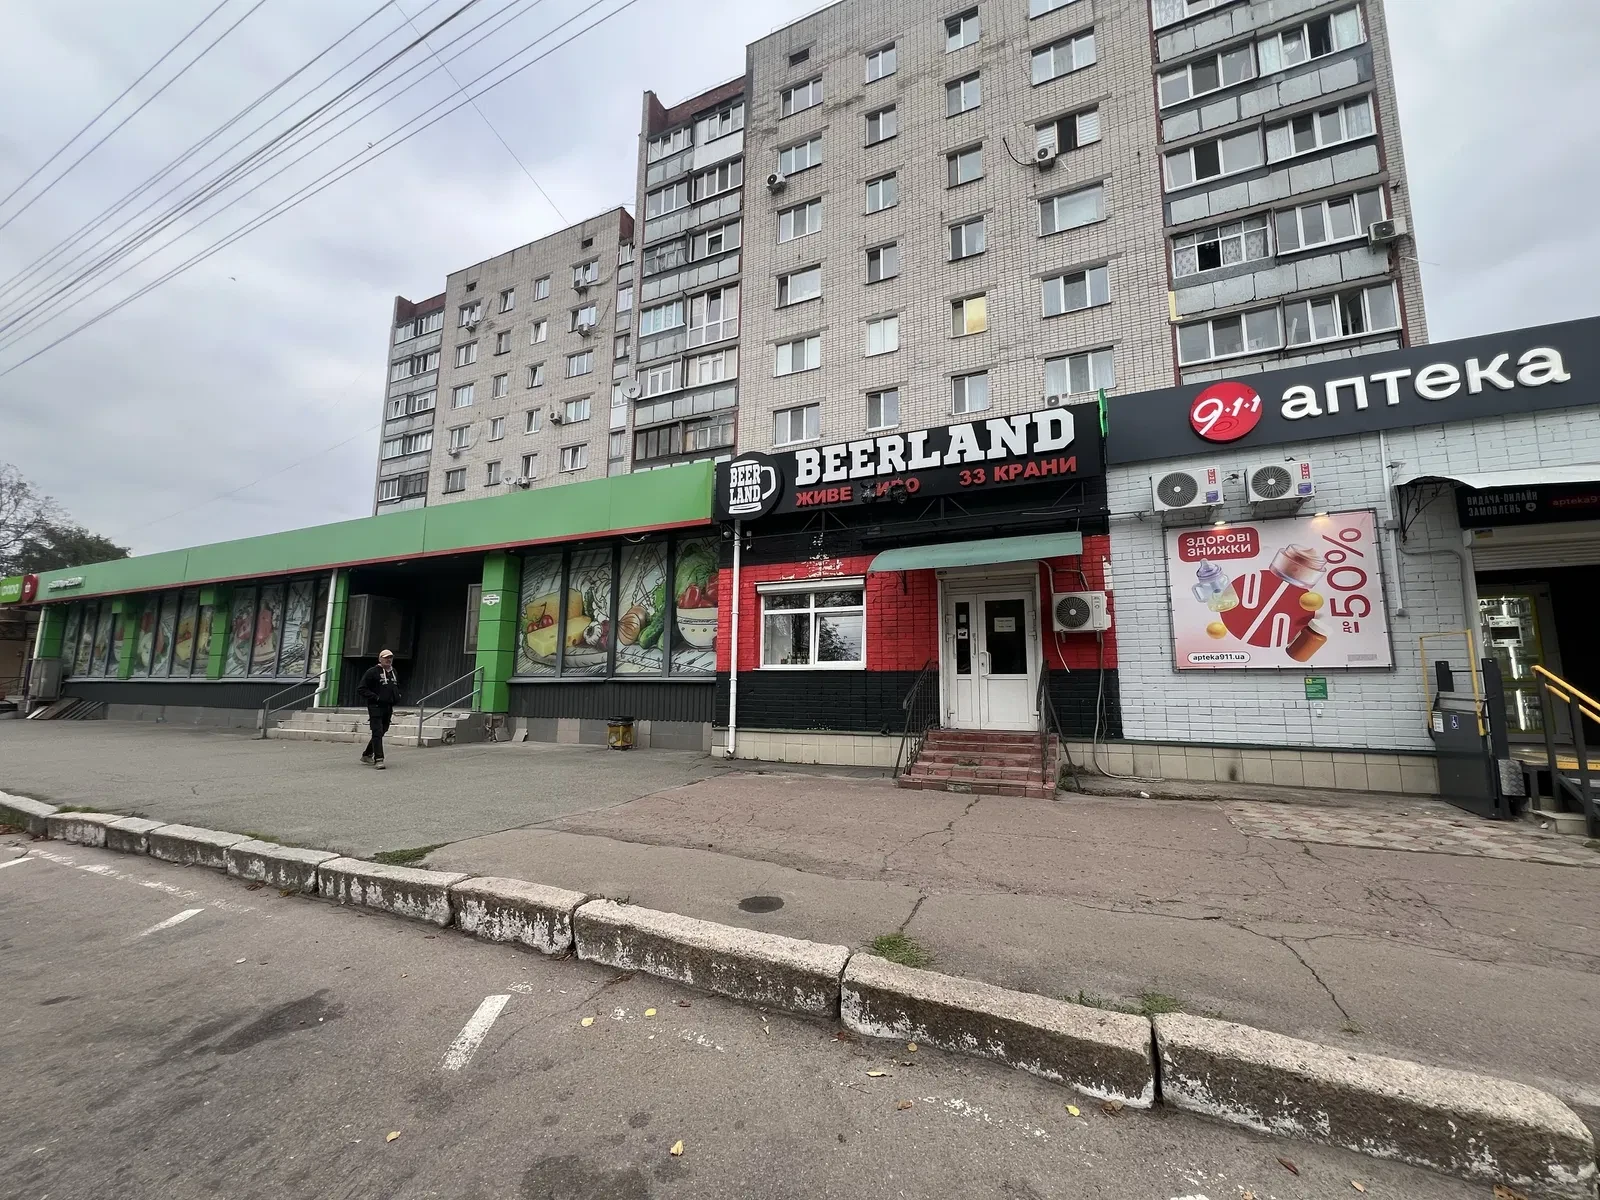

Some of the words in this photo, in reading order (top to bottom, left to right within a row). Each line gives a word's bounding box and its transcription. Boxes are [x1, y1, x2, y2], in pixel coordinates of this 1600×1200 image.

[1280, 347, 1571, 420] аптека
[795, 408, 1075, 486] BEERLAND
[729, 463, 761, 488] BEER
[795, 486, 853, 507] ЖИВЕ
[959, 468, 986, 485] 33
[994, 456, 1077, 482] КРАНИ
[729, 484, 761, 505] LAND
[1468, 504, 1520, 516] ЗАМОВЛЕНЬ
[1186, 533, 1250, 547] ЗДОРОВІ
[1187, 544, 1251, 557] ЗНИЖКИ
[1193, 653, 1245, 662] apteka911.ua
